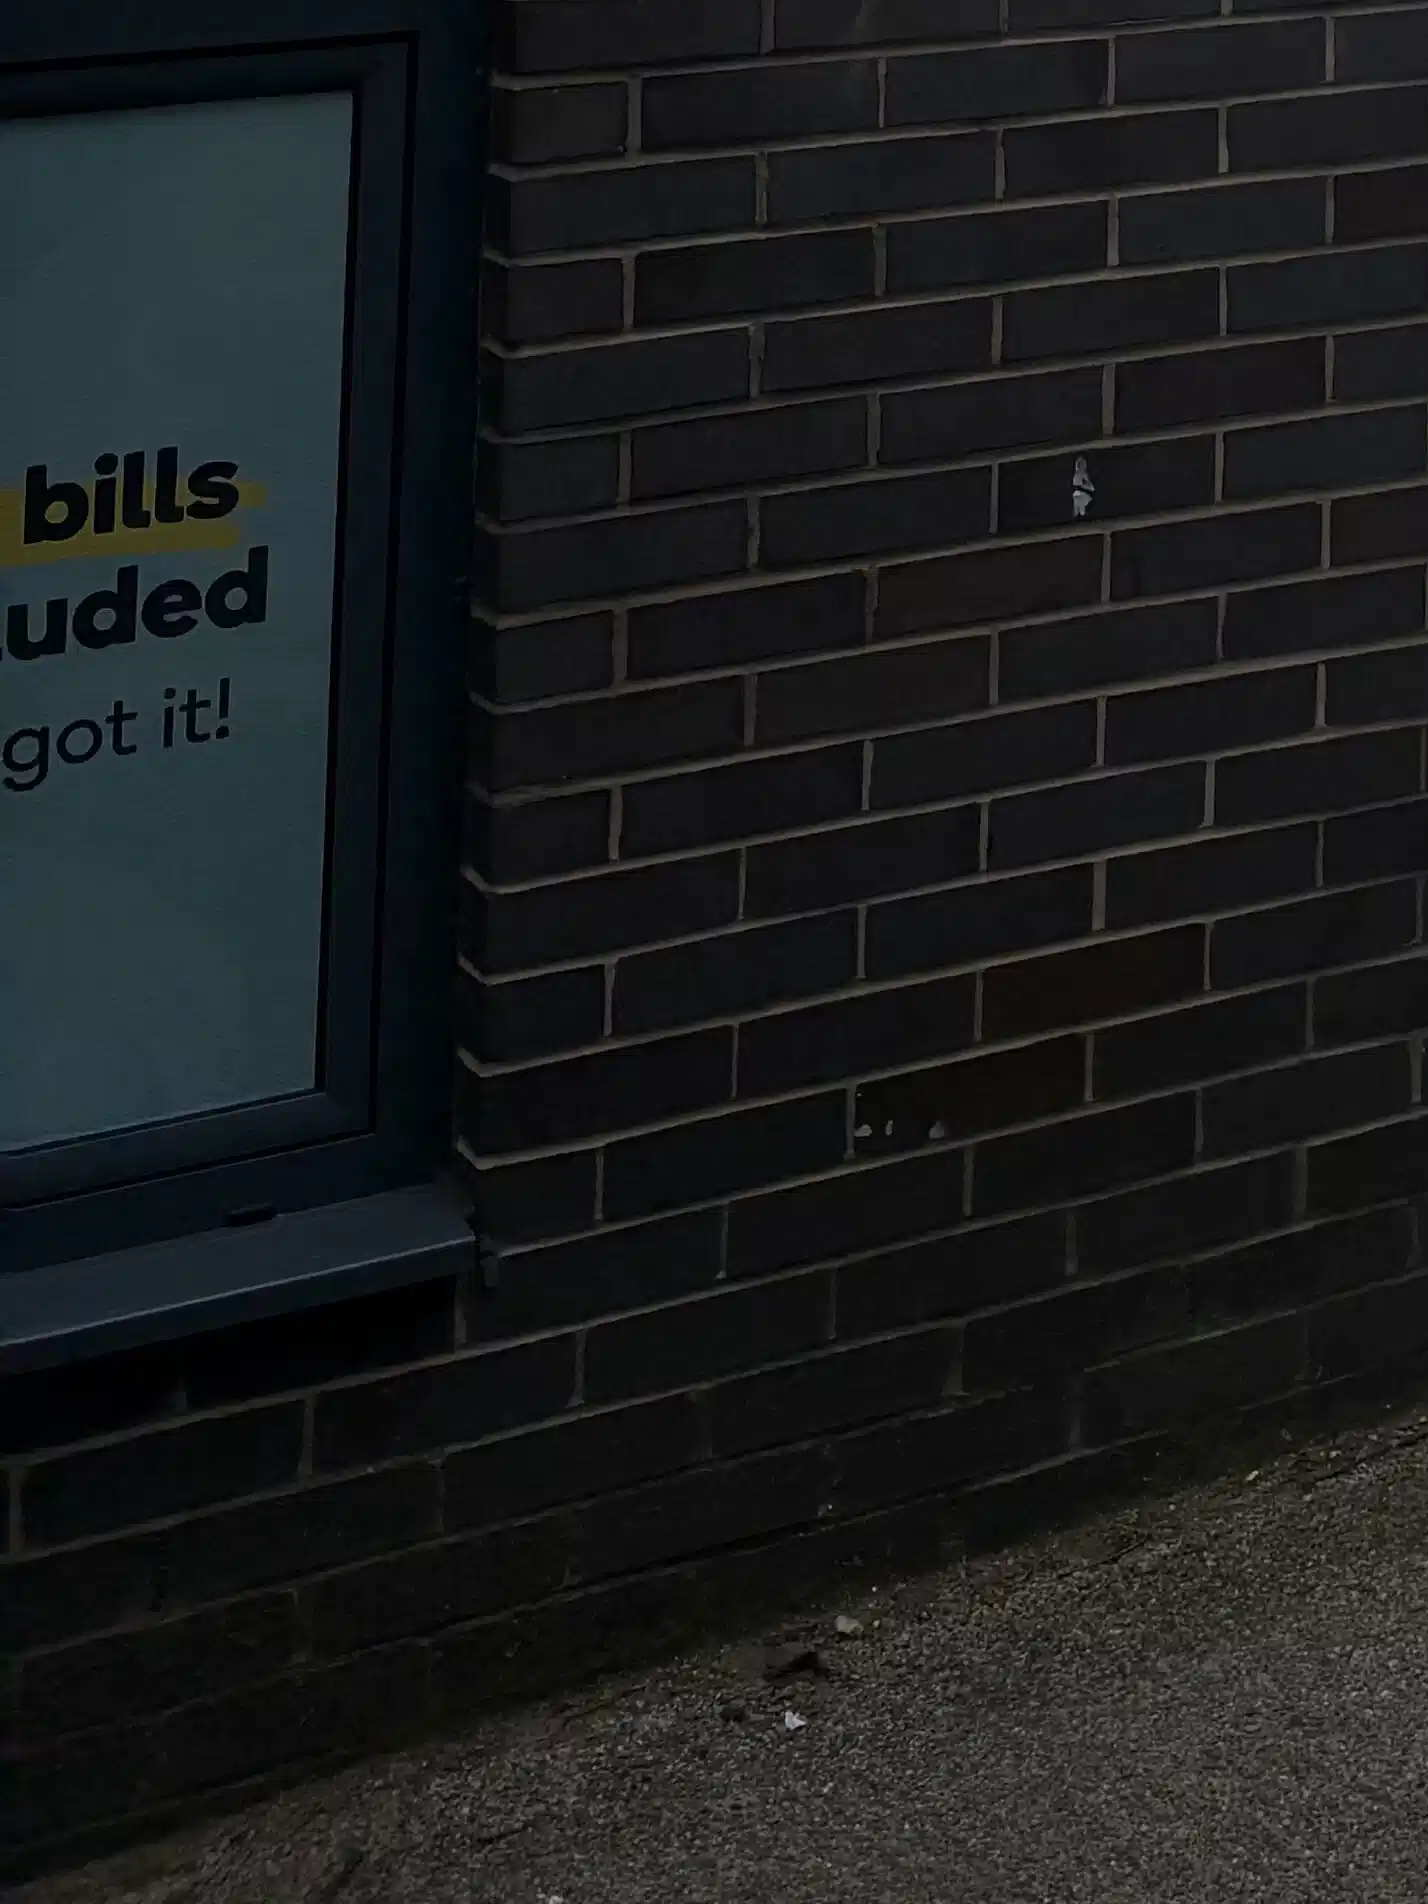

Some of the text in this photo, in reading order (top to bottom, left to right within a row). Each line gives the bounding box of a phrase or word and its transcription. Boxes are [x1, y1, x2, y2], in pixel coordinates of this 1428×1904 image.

[23, 445, 239, 544] bills
[0, 545, 269, 661] uded
[2, 676, 231, 792] got it!
